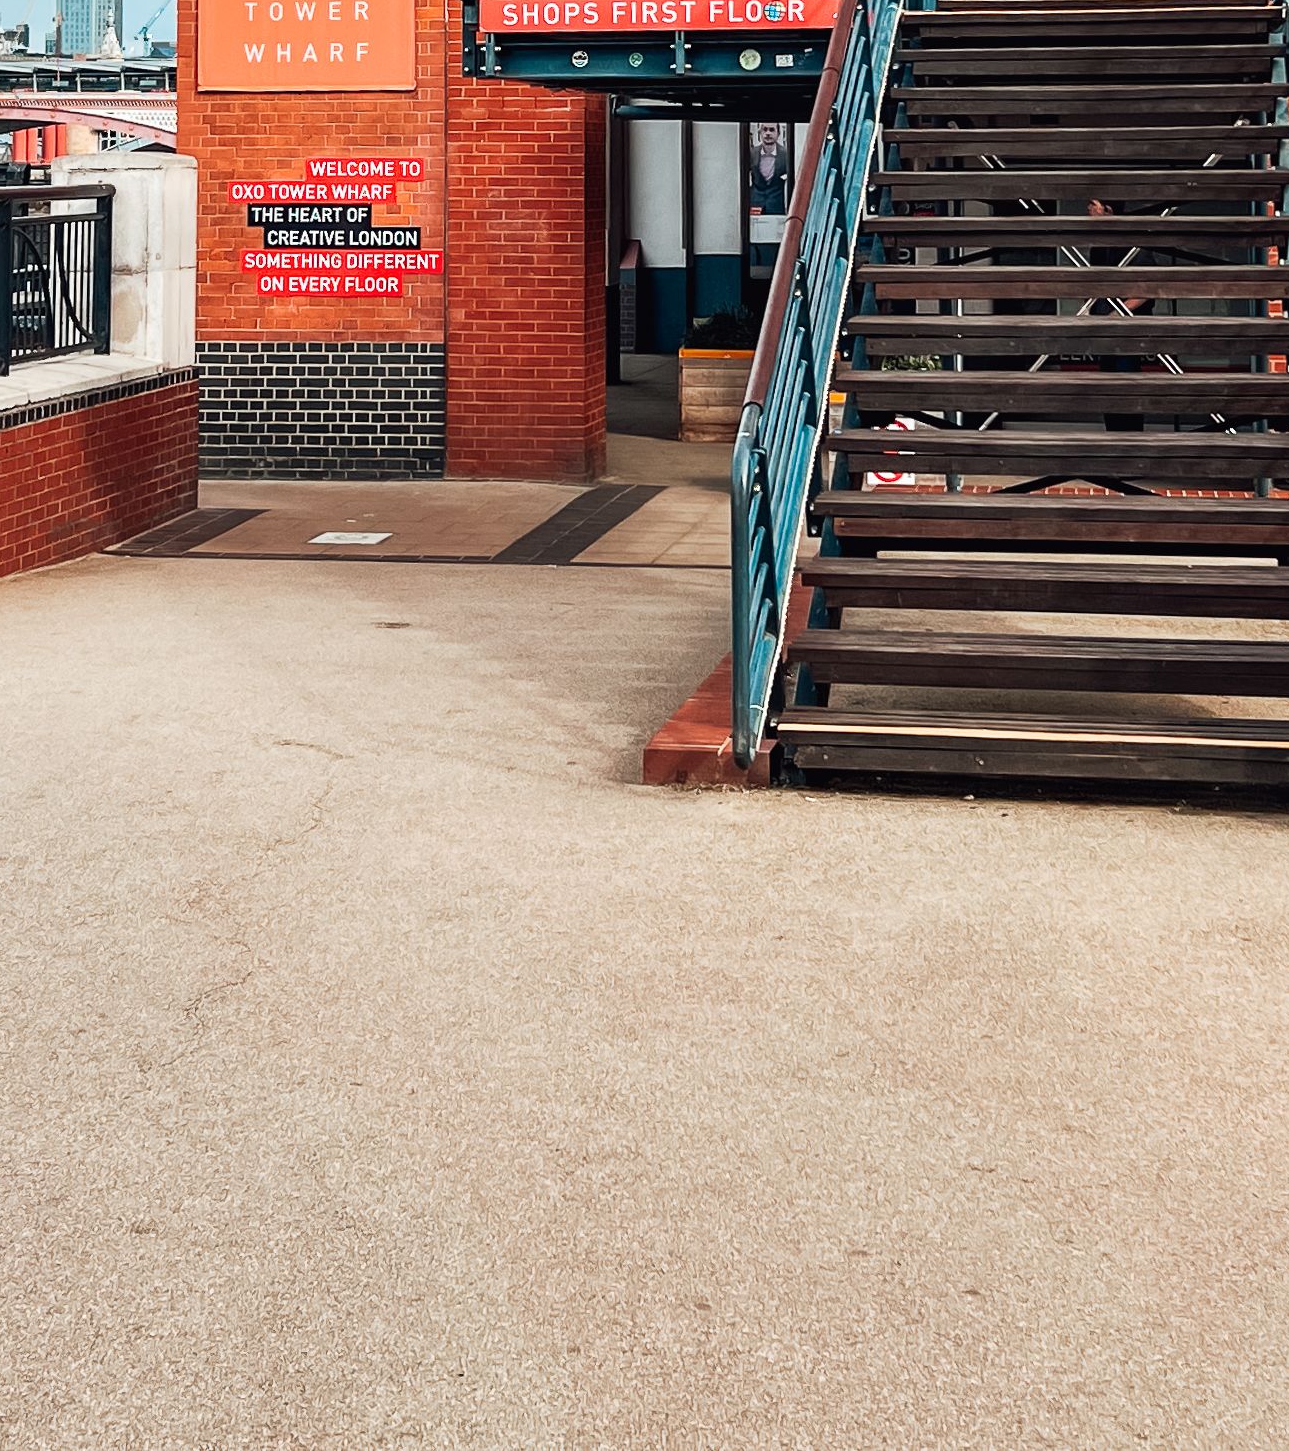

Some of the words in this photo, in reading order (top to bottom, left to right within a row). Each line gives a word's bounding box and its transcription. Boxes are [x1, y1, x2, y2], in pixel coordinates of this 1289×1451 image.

[245, 1, 368, 21] TOWER
[503, 2, 598, 25] SHOPS
[613, 1, 695, 23] FIRST
[710, 0, 804, 22] FLOR
[245, 43, 368, 62] WHARF
[310, 161, 394, 176] WELCOME
[399, 161, 420, 176] TO
[232, 184, 264, 199] OXO
[268, 184, 327, 199] TOWER
[331, 185, 392, 199] WHARF
[252, 207, 284, 222] THE
[288, 207, 340, 222] HEART
[346, 207, 368, 222] OF
[268, 230, 344, 245] CREATIVE
[350, 231, 417, 246] LONDON
[245, 253, 341, 268] SOMETHING
[347, 254, 439, 269] DIFFERENT
[261, 277, 283, 291] ON
[289, 277, 340, 291] EVERY
[345, 277, 398, 292] FLOOR
